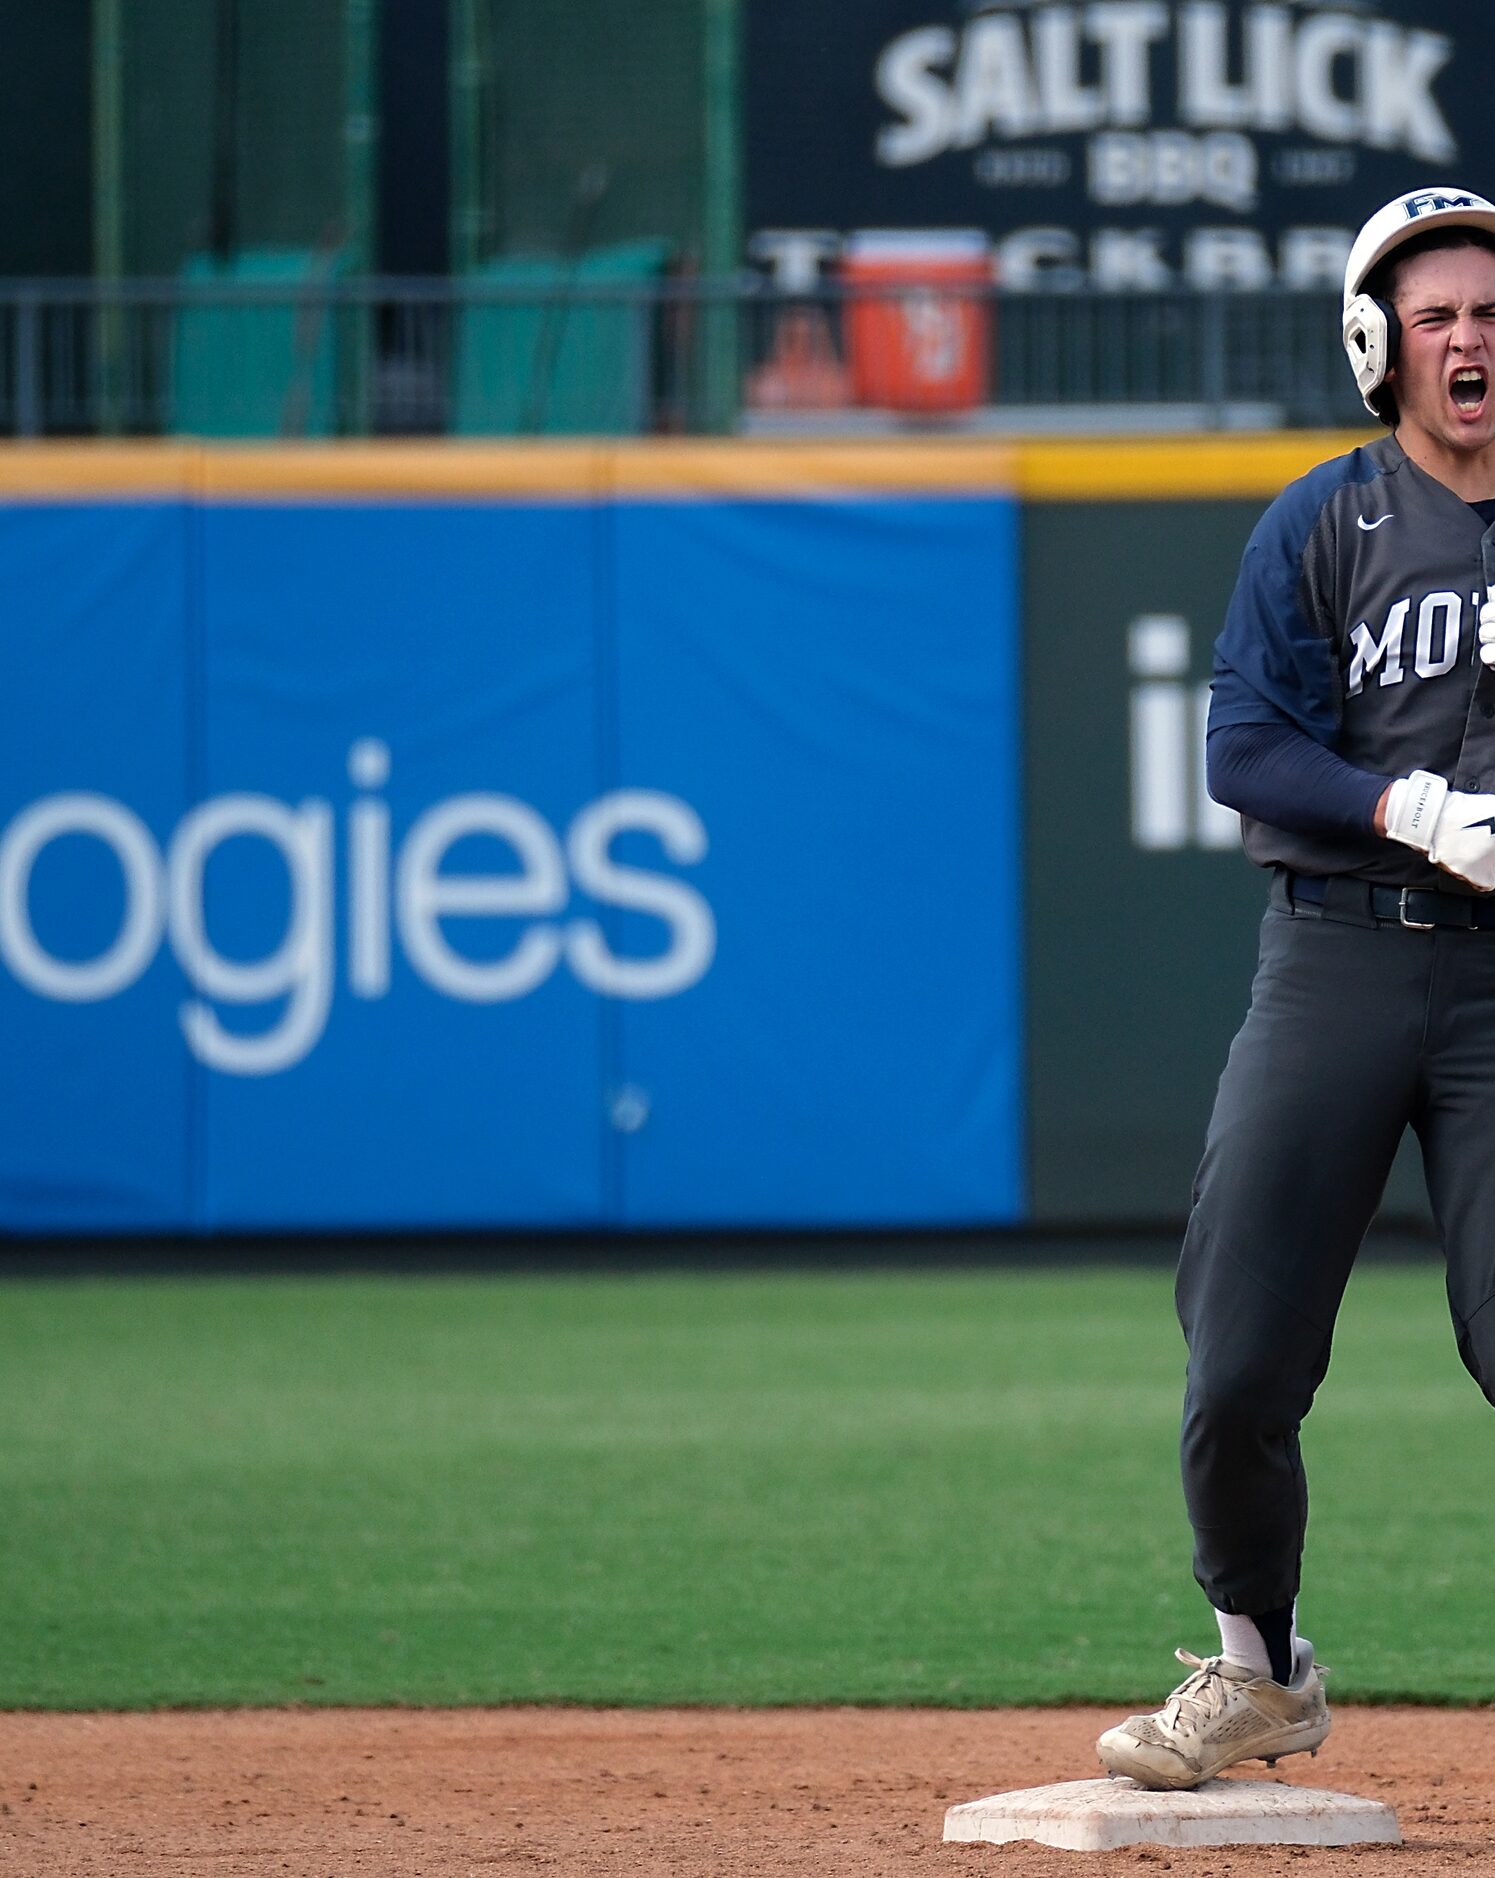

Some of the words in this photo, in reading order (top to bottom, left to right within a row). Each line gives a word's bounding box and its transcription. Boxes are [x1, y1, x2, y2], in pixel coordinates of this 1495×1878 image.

[874, 2, 1168, 167] SALT
[1176, 2, 1460, 165] LICK
[1086, 130, 1259, 213] BBQ
[1403, 193, 1476, 219] FM
[0, 737, 717, 1077] ogies
